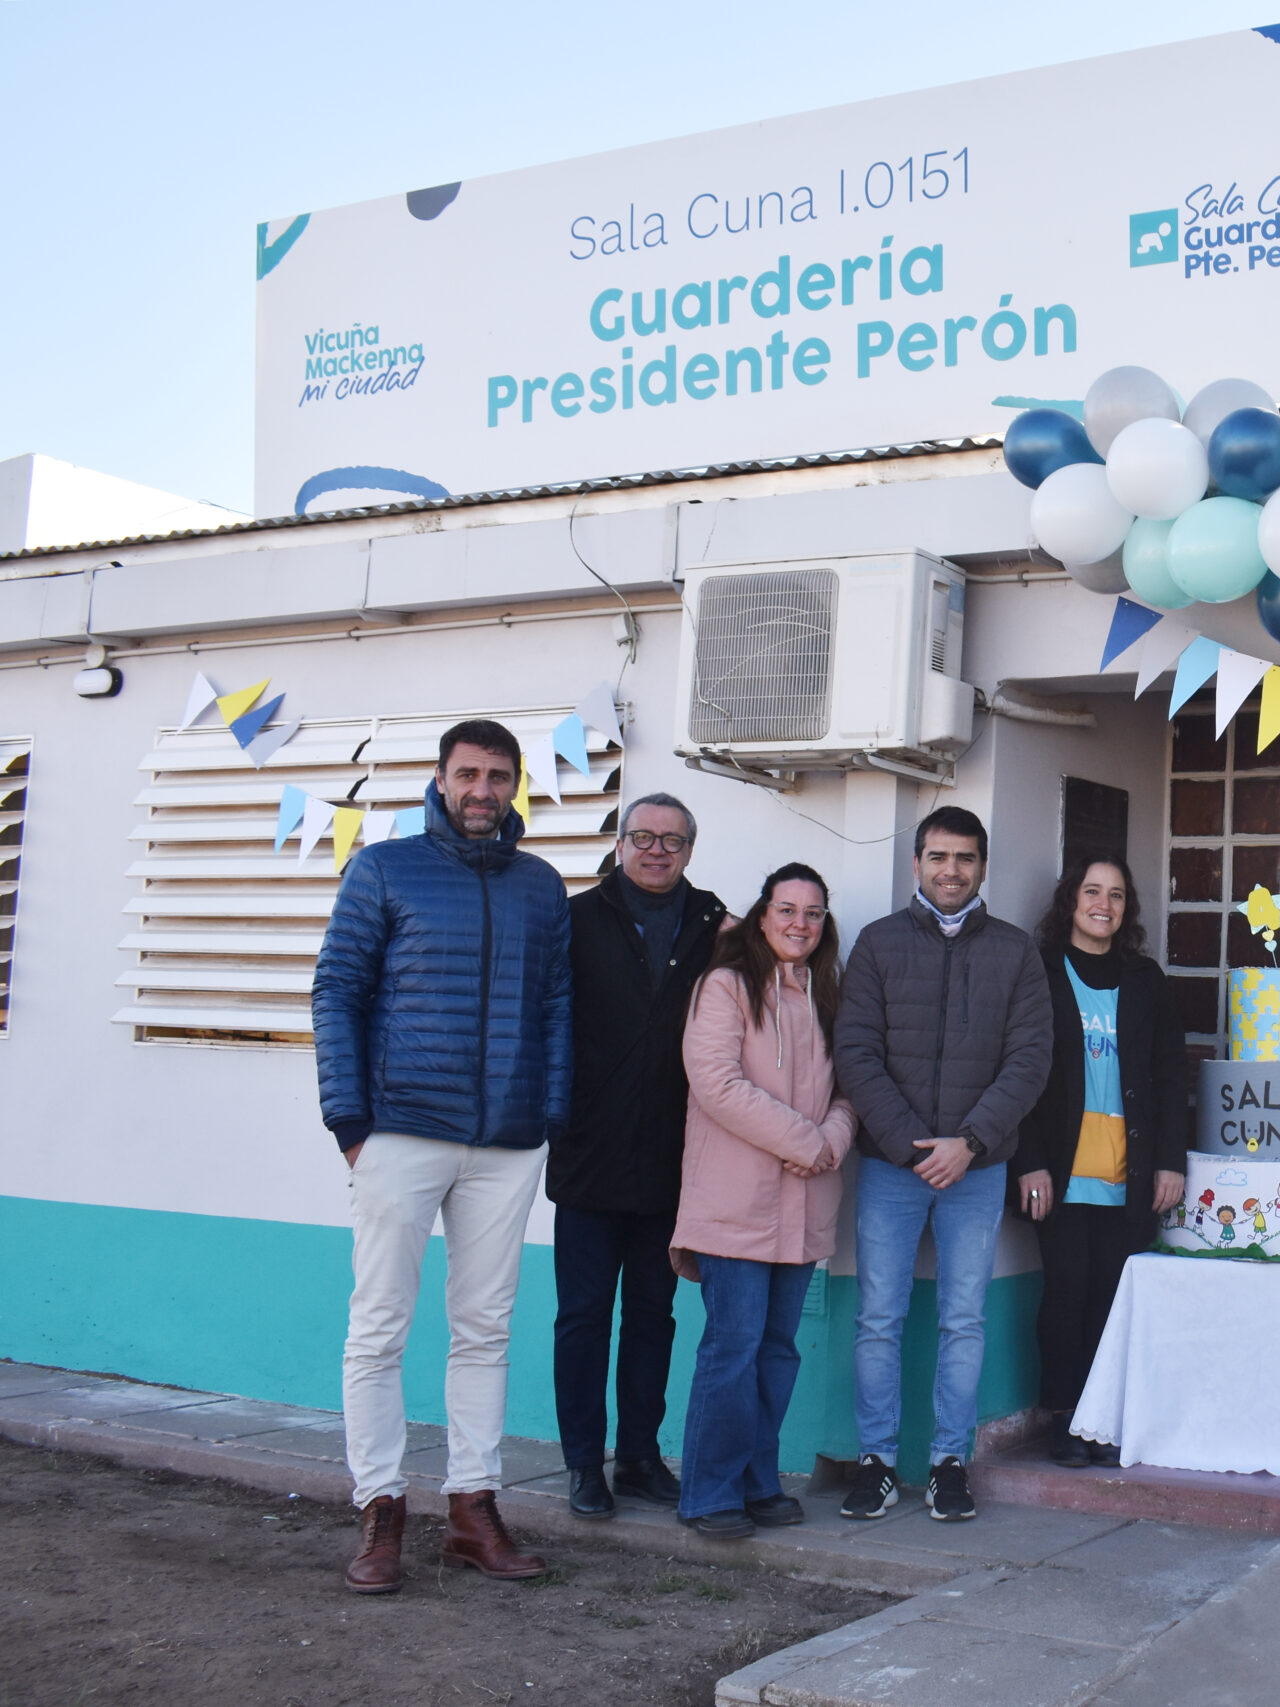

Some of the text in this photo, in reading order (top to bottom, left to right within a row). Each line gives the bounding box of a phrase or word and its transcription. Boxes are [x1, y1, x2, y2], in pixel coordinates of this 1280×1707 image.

[569, 203, 668, 260] Sala
[687, 185, 818, 239] Cuna
[1184, 182, 1245, 226] Sala
[1184, 250, 1240, 279] Pte.
[589, 235, 944, 342] Guardería
[304, 322, 424, 380] Vicuña Mackenna
[487, 294, 1078, 428] Presidente Perón
[335, 355, 426, 400] ciudad
[1080, 1011, 1117, 1034] SAL
[1084, 1034, 1118, 1058] UN
